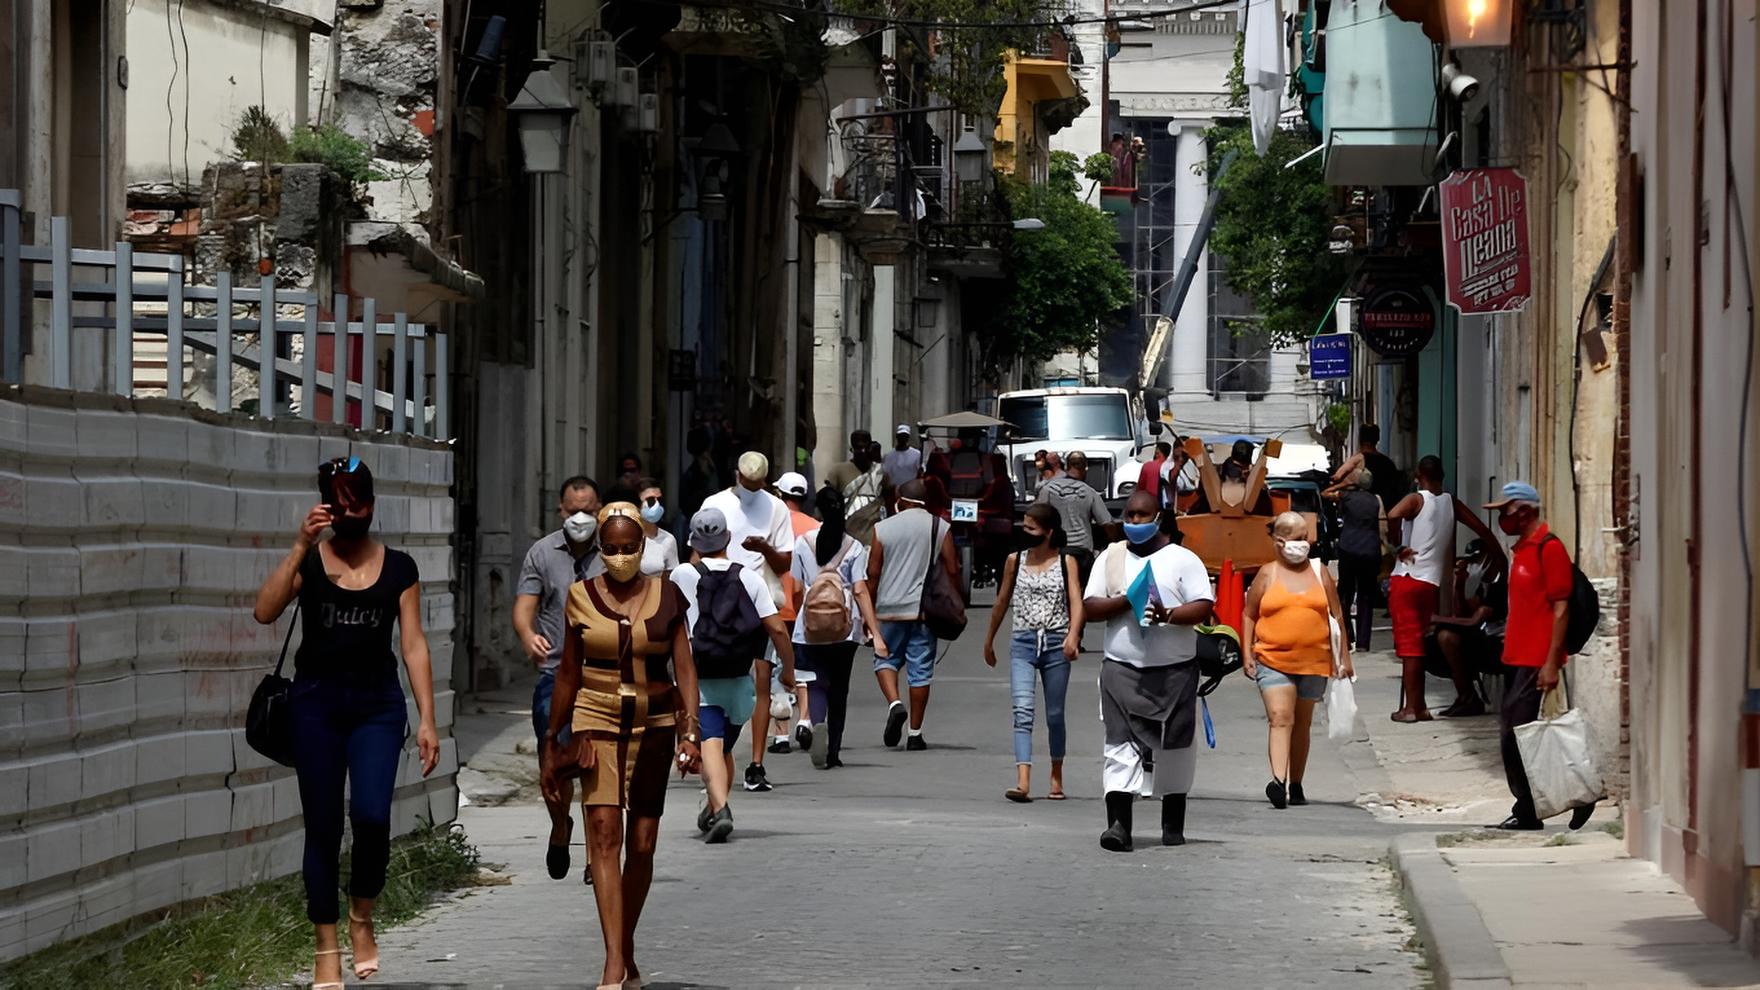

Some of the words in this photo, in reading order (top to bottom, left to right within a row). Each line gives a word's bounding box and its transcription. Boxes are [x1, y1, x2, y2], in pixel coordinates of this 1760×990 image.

[1472, 175, 1492, 204] LA
[1451, 200, 1494, 241] Casa
[321, 602, 383, 628] Juicy
